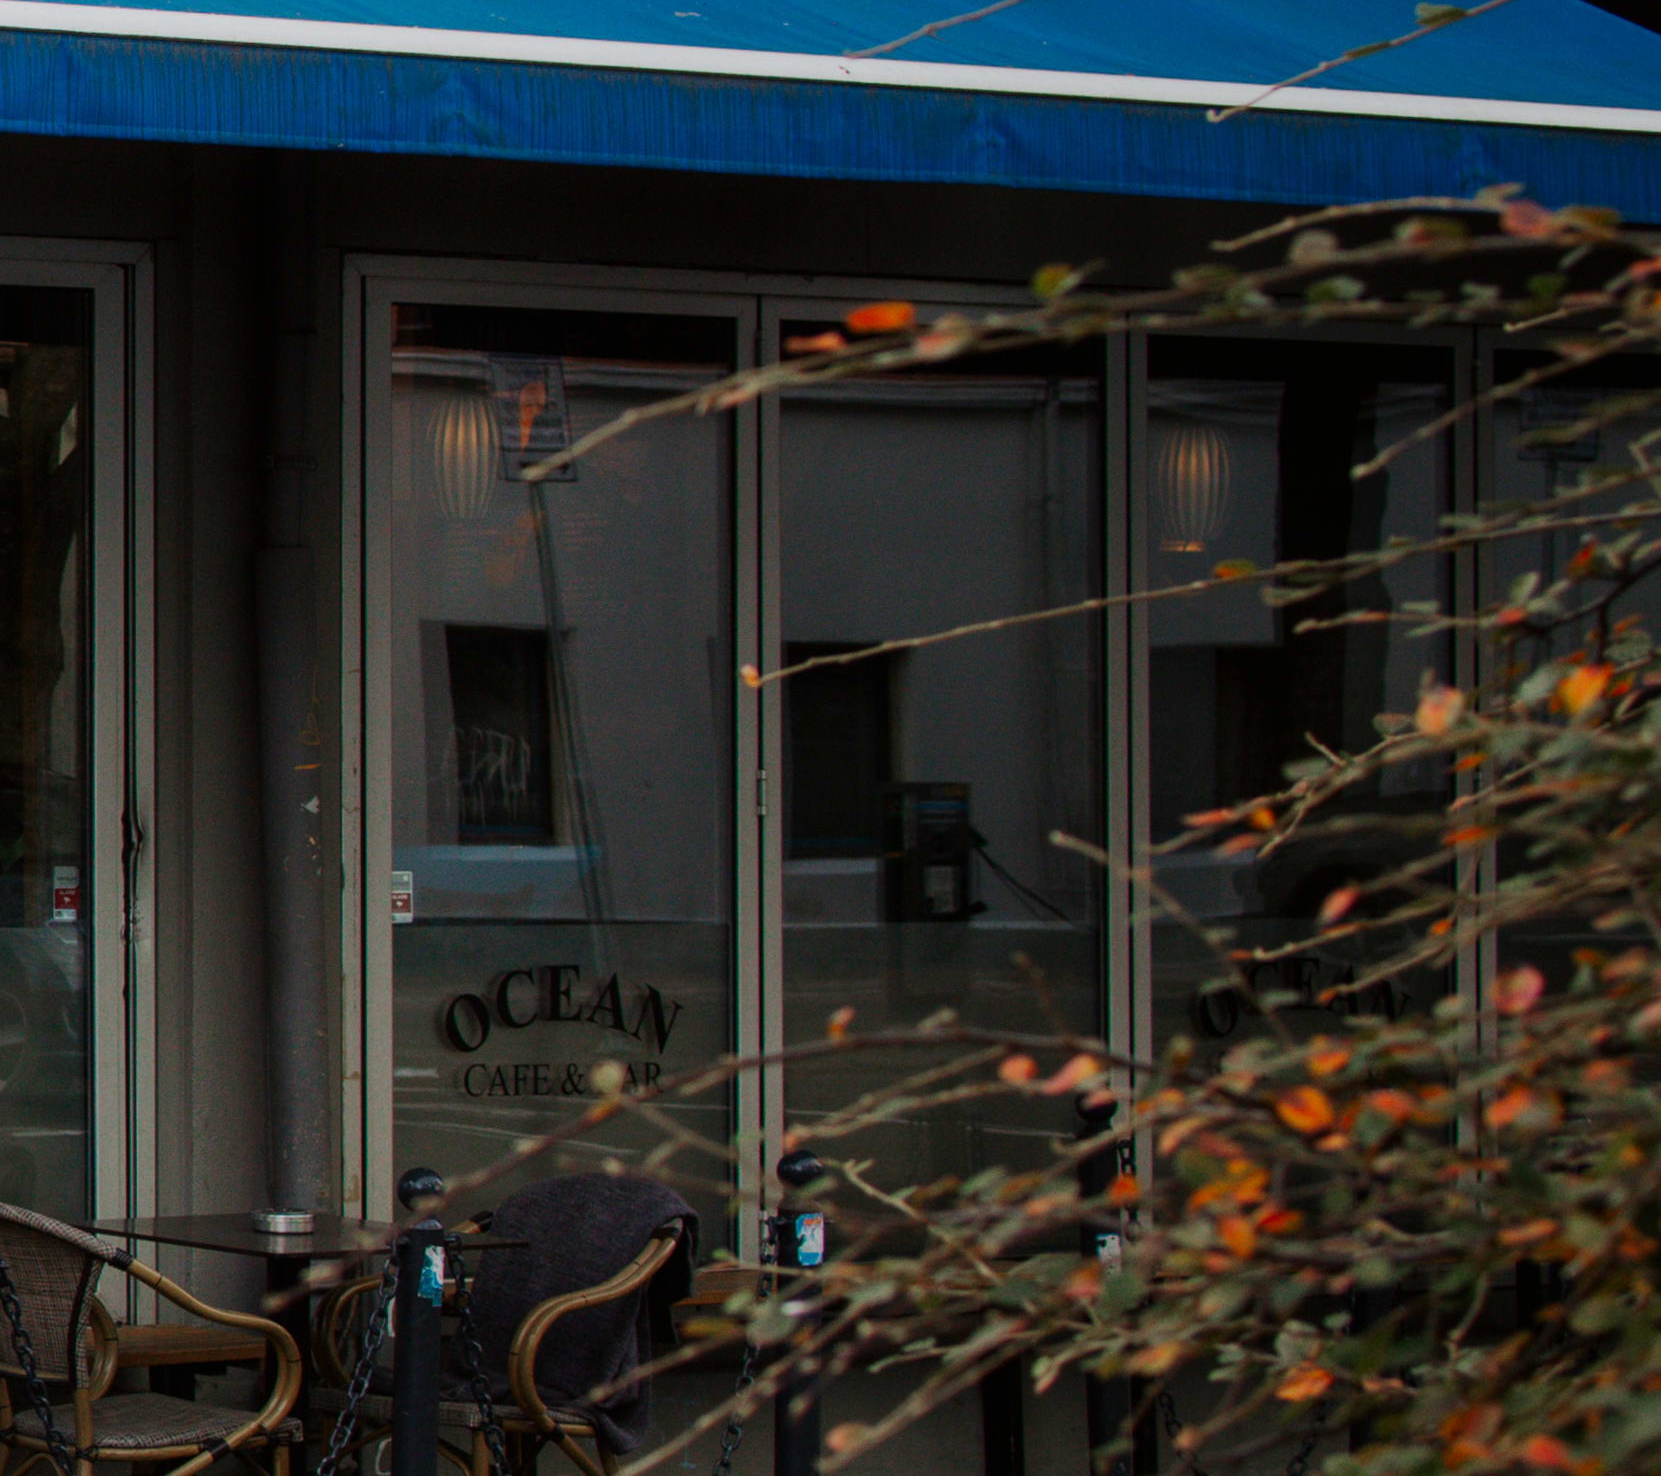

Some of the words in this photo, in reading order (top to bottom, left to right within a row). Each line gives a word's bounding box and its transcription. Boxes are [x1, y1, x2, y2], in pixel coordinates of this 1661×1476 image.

[446, 965, 683, 1055] OCEAN
[464, 1063, 550, 1097] CAFE
[561, 1063, 584, 1095] &
[604, 1062, 664, 1093] AR
